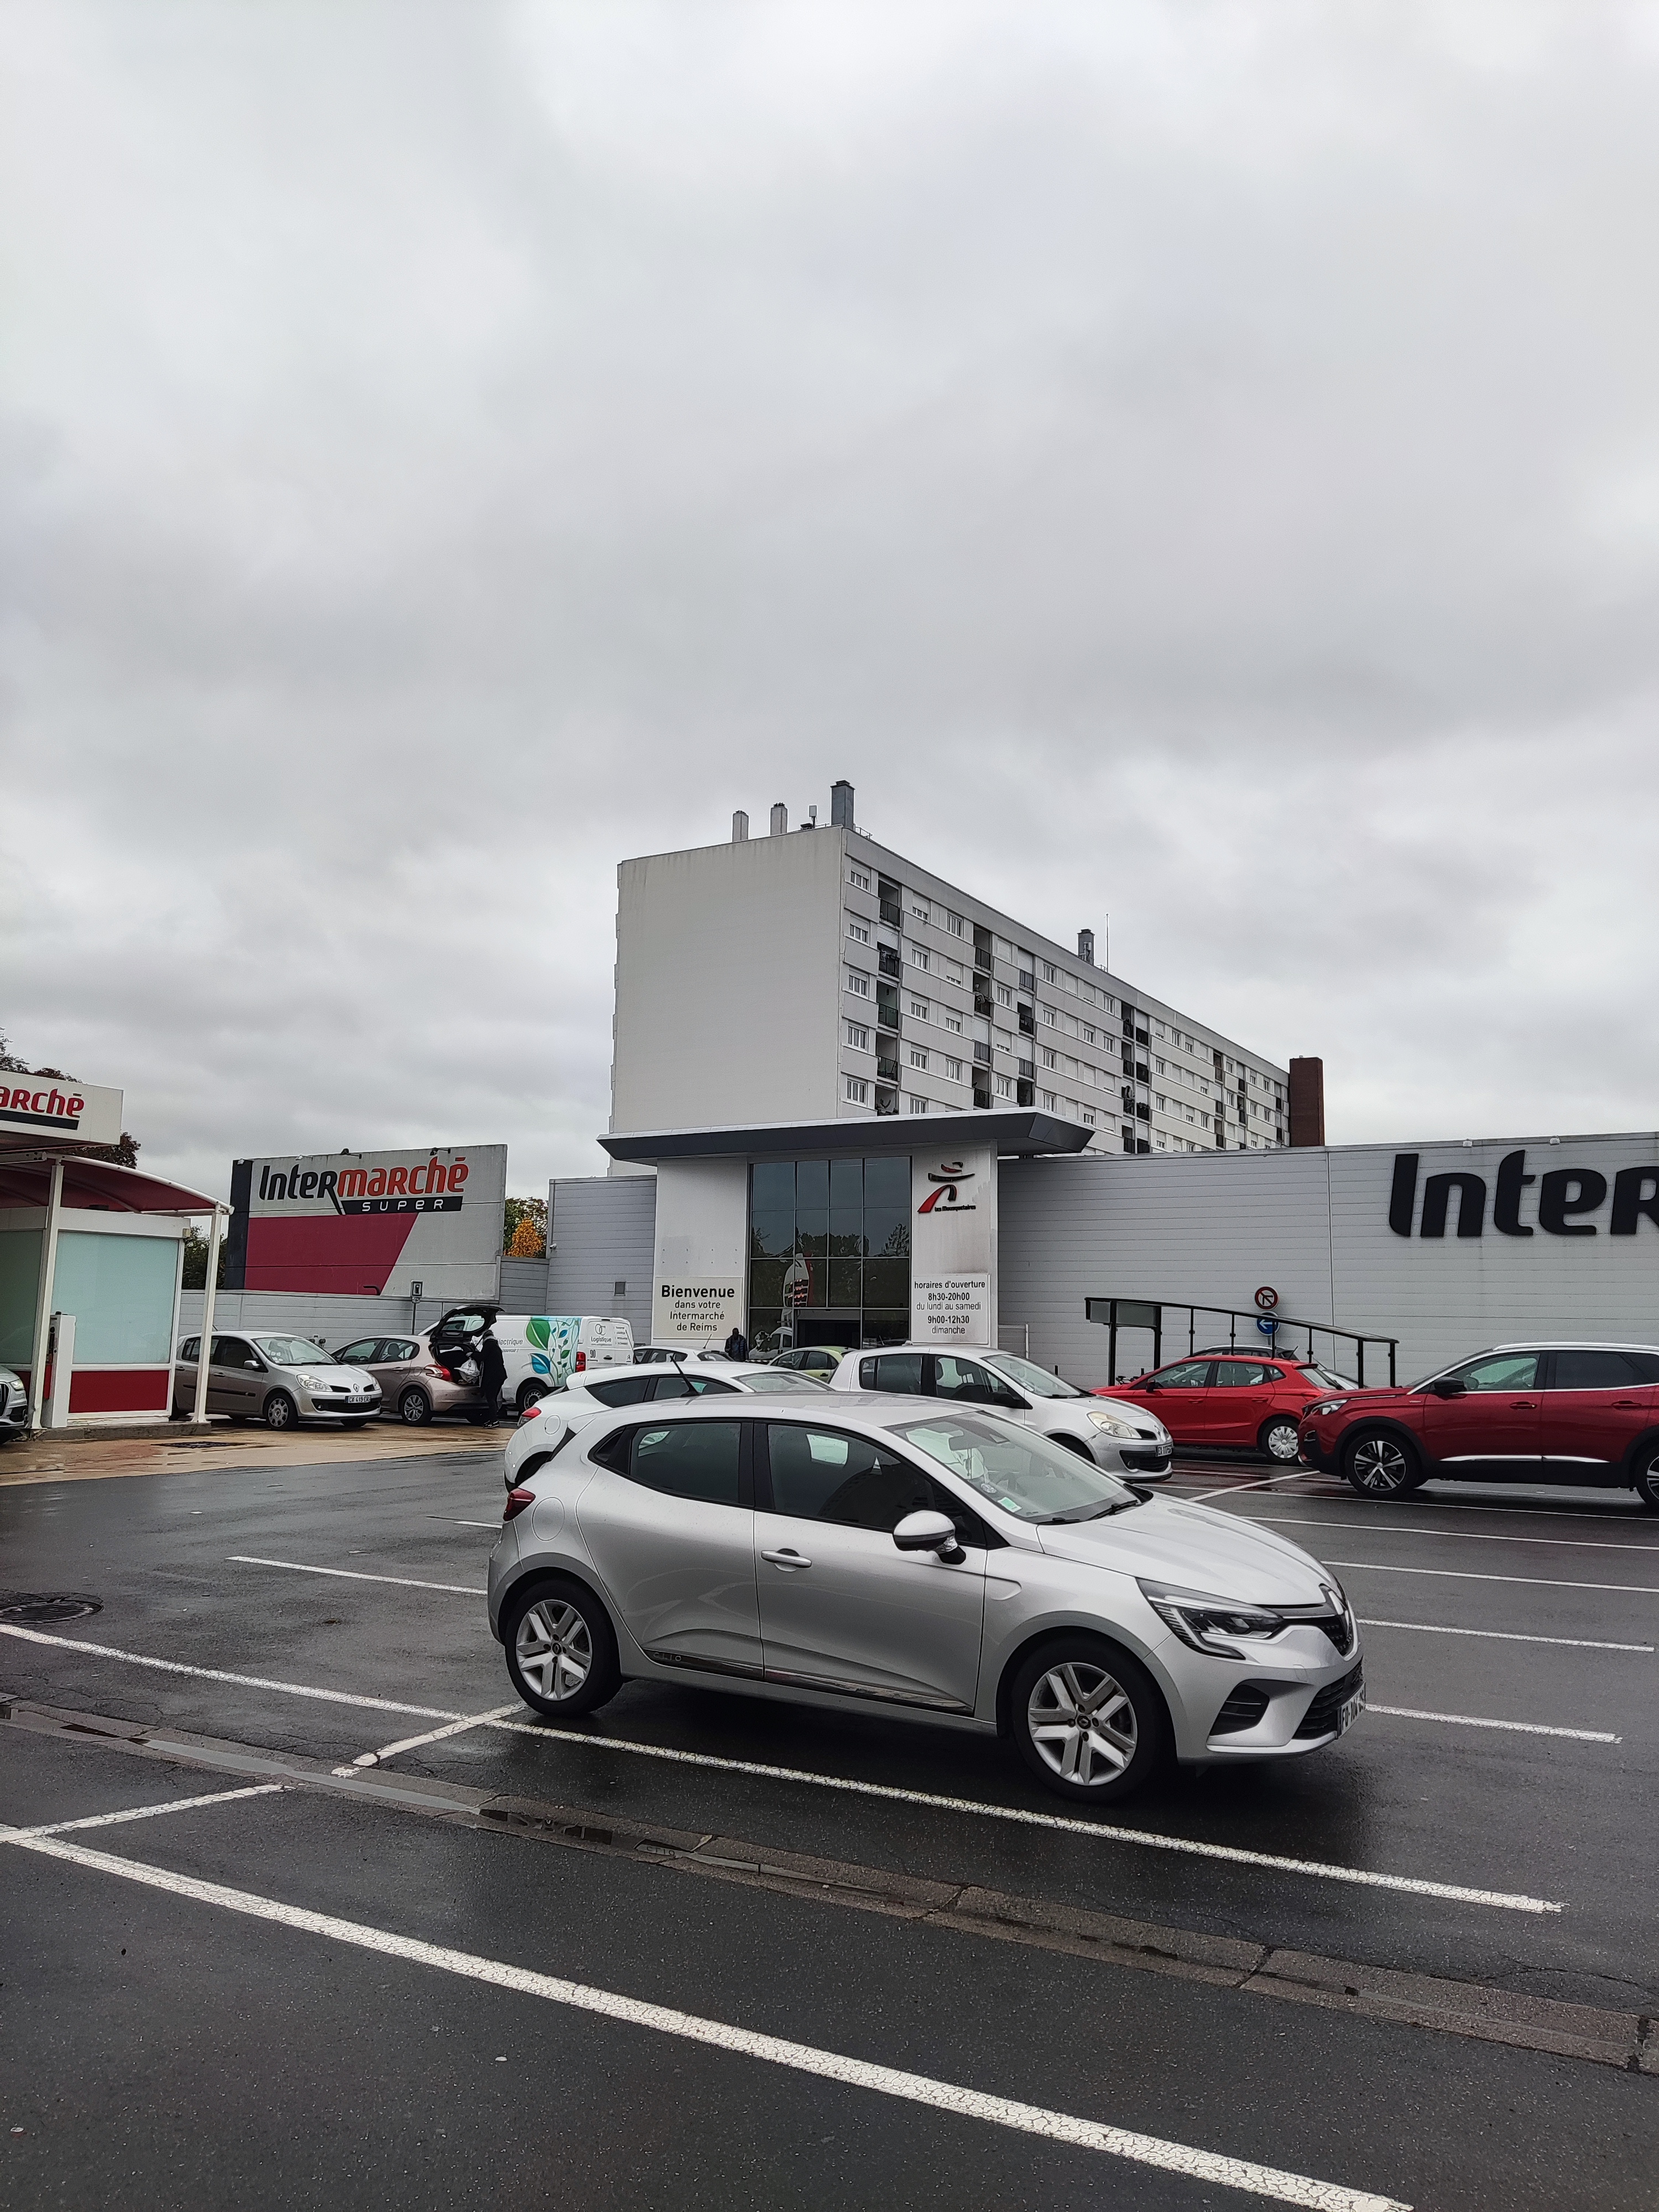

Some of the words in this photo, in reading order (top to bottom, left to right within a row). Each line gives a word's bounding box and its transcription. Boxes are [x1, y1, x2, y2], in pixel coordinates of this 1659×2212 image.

[259, 1156, 469, 1215] Intermarché
[362, 1199, 444, 1212] SUPER
[661, 1285, 735, 1298] Bienvenue
[928, 1292, 970, 1301] 8h30-20h00
[675, 1300, 696, 1308] dans
[927, 1302, 943, 1310] lundi
[955, 1302, 981, 1310] samedi
[670, 1311, 725, 1320] Intermarché
[927, 1316, 970, 1324] 9h00-12h30
[676, 1322, 687, 1331] de
[690, 1322, 718, 1331] Reims
[932, 1325, 966, 1334] dimanche
